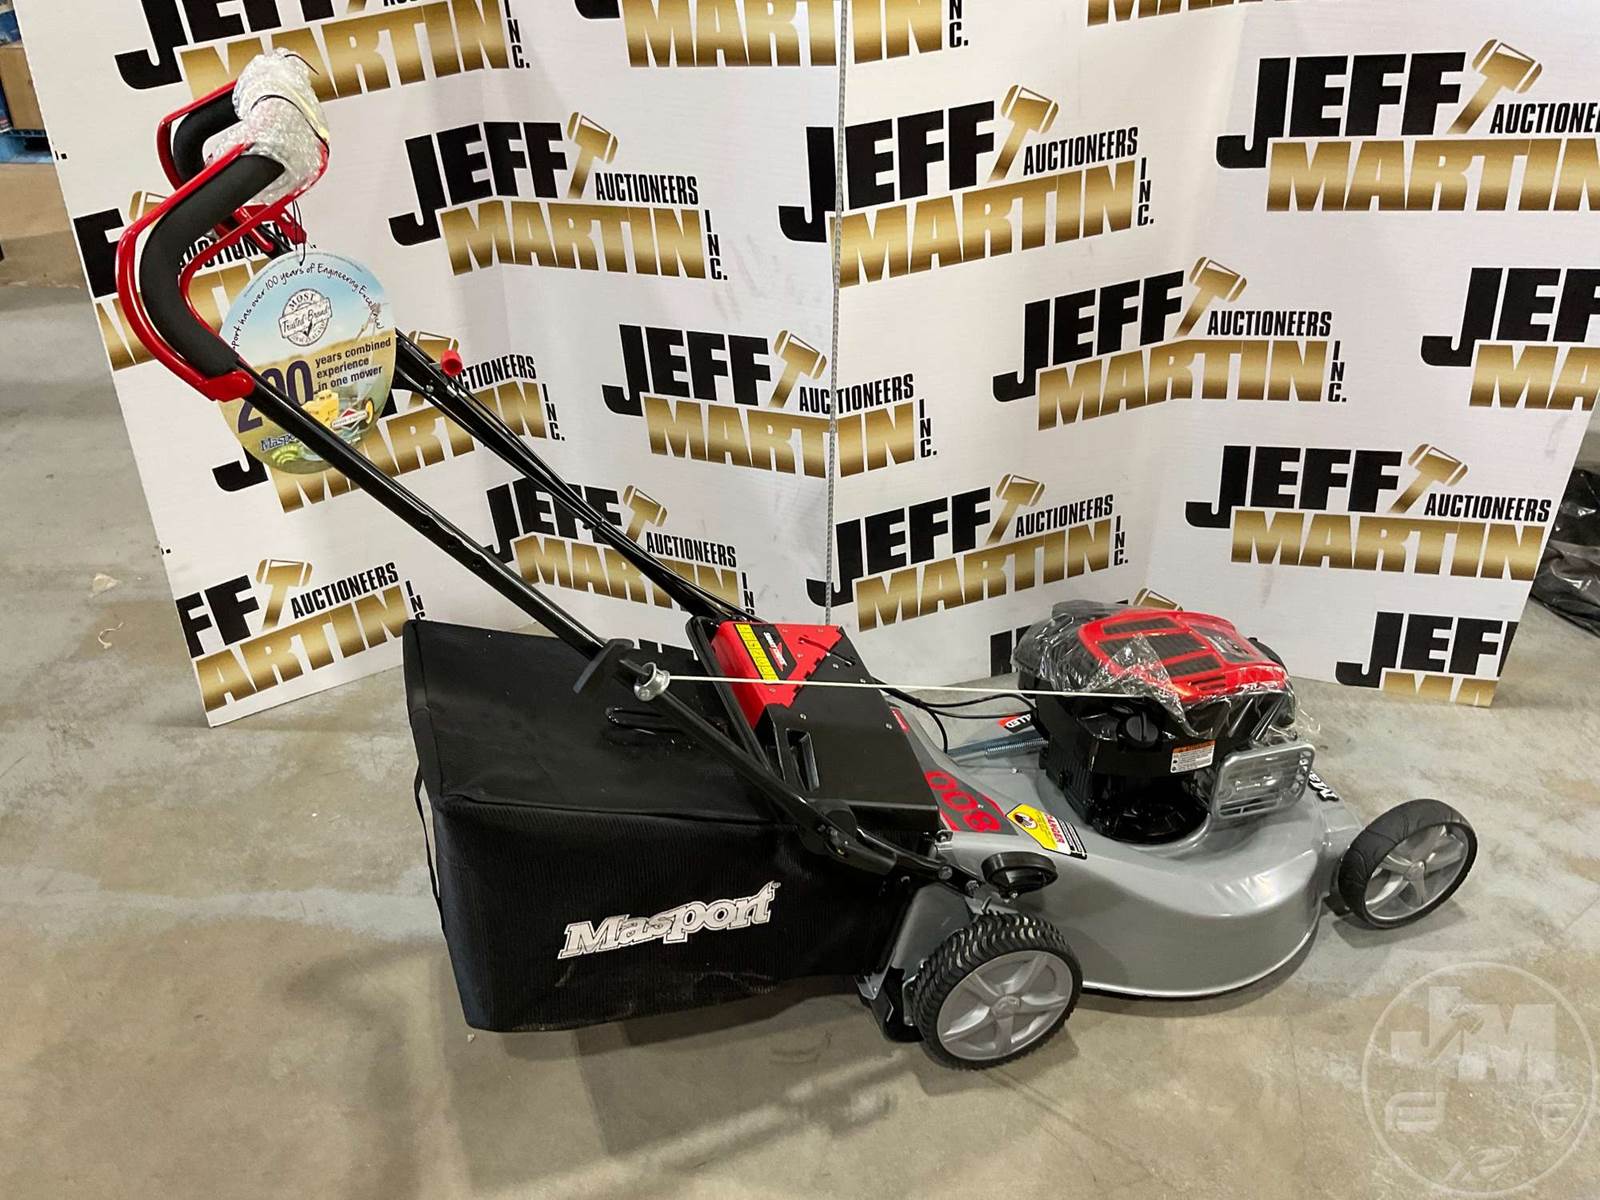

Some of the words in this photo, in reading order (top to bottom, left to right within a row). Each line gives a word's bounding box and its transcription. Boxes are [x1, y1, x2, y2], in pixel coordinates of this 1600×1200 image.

[623, 0, 944, 67] MARTIN
[1216, 52, 1466, 168] JEFF
[1489, 103, 1600, 134] AUCTIONE
[388, 121, 568, 247] JEFF
[778, 100, 995, 243] JEFF
[1023, 127, 1138, 177] AUCTIONEERS
[595, 173, 699, 205] AUCTIONEERS
[1137, 157, 1154, 226] INC.
[440, 200, 707, 280] MARTIN
[705, 209, 728, 281] INC.
[829, 160, 1135, 288] MARTIN
[239, 308, 252, 326] has
[252, 290, 266, 308] over
[265, 275, 279, 291] 100
[279, 266, 304, 285] years
[306, 263, 315, 274] of
[1207, 310, 1332, 337] AUCTIONEERS
[315, 352, 342, 368] years
[345, 337, 392, 359] combined
[317, 358, 369, 379] experience
[992, 270, 1185, 402] JEFF
[318, 380, 328, 393] in
[331, 374, 348, 388] one
[350, 365, 383, 381] mower
[602, 324, 771, 416] JEFF
[799, 374, 914, 414] AUCTIONEERS
[1038, 340, 1328, 431] MARTIN
[1328, 340, 1347, 402] INC.
[542, 383, 566, 441] INC.
[643, 397, 915, 478] MARTIN
[919, 398, 937, 458] INC.
[1015, 494, 1114, 539] AUCTIONEERS
[1185, 445, 1402, 528] JEFF
[1424, 493, 1552, 523] AUCTIONEERS
[646, 532, 737, 568] AUCTIONEERS
[806, 487, 990, 608] JEFF
[1114, 515, 1129, 566] INC.
[1231, 510, 1546, 581] MARTIN
[290, 562, 399, 619] AUCTIONEERS
[857, 519, 1112, 632] MARTIN
[557, 882, 776, 959] Masport
